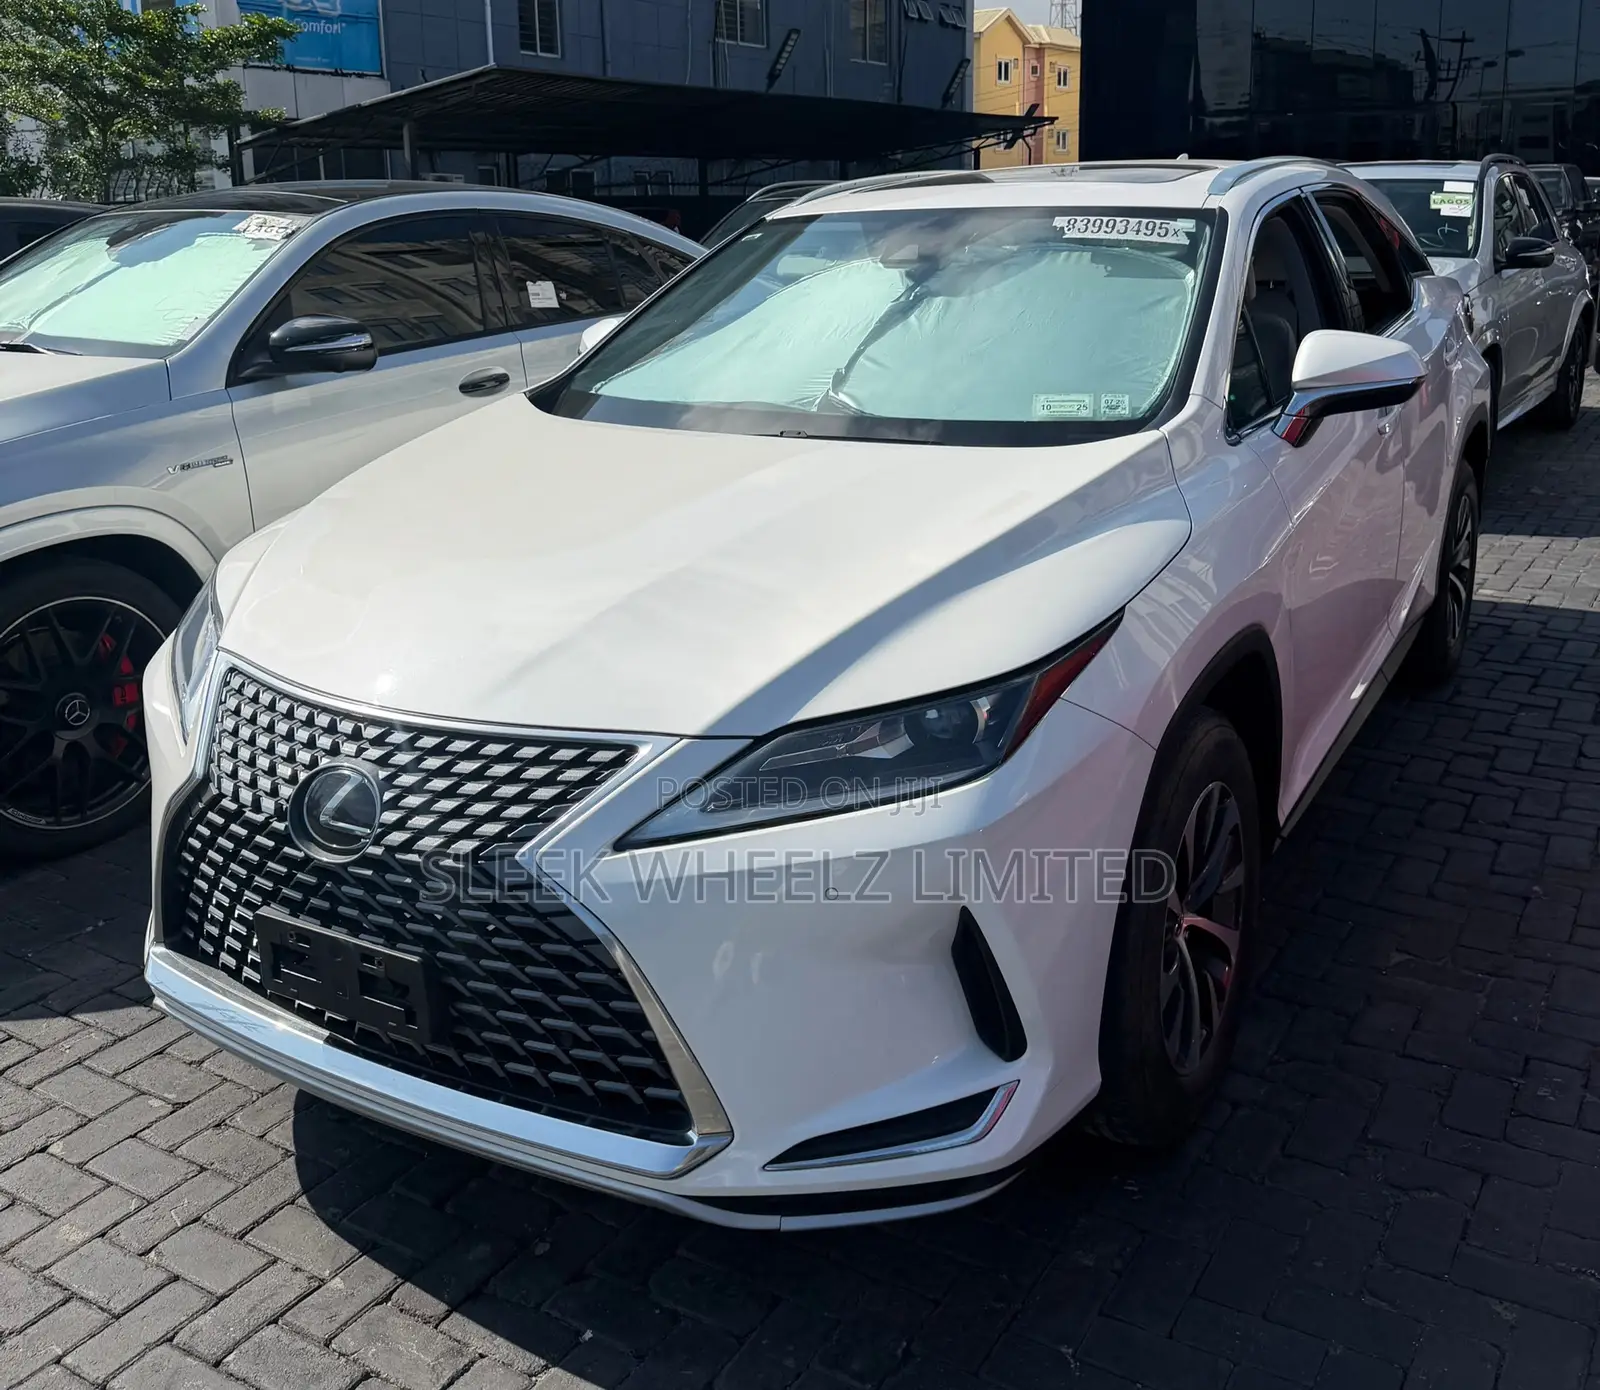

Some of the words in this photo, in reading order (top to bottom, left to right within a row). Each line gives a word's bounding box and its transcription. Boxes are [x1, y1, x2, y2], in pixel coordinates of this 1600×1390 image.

[1432, 197, 1471, 205] LAGOS
[1041, 403, 1052, 411] 10
[1076, 403, 1089, 411] 25
